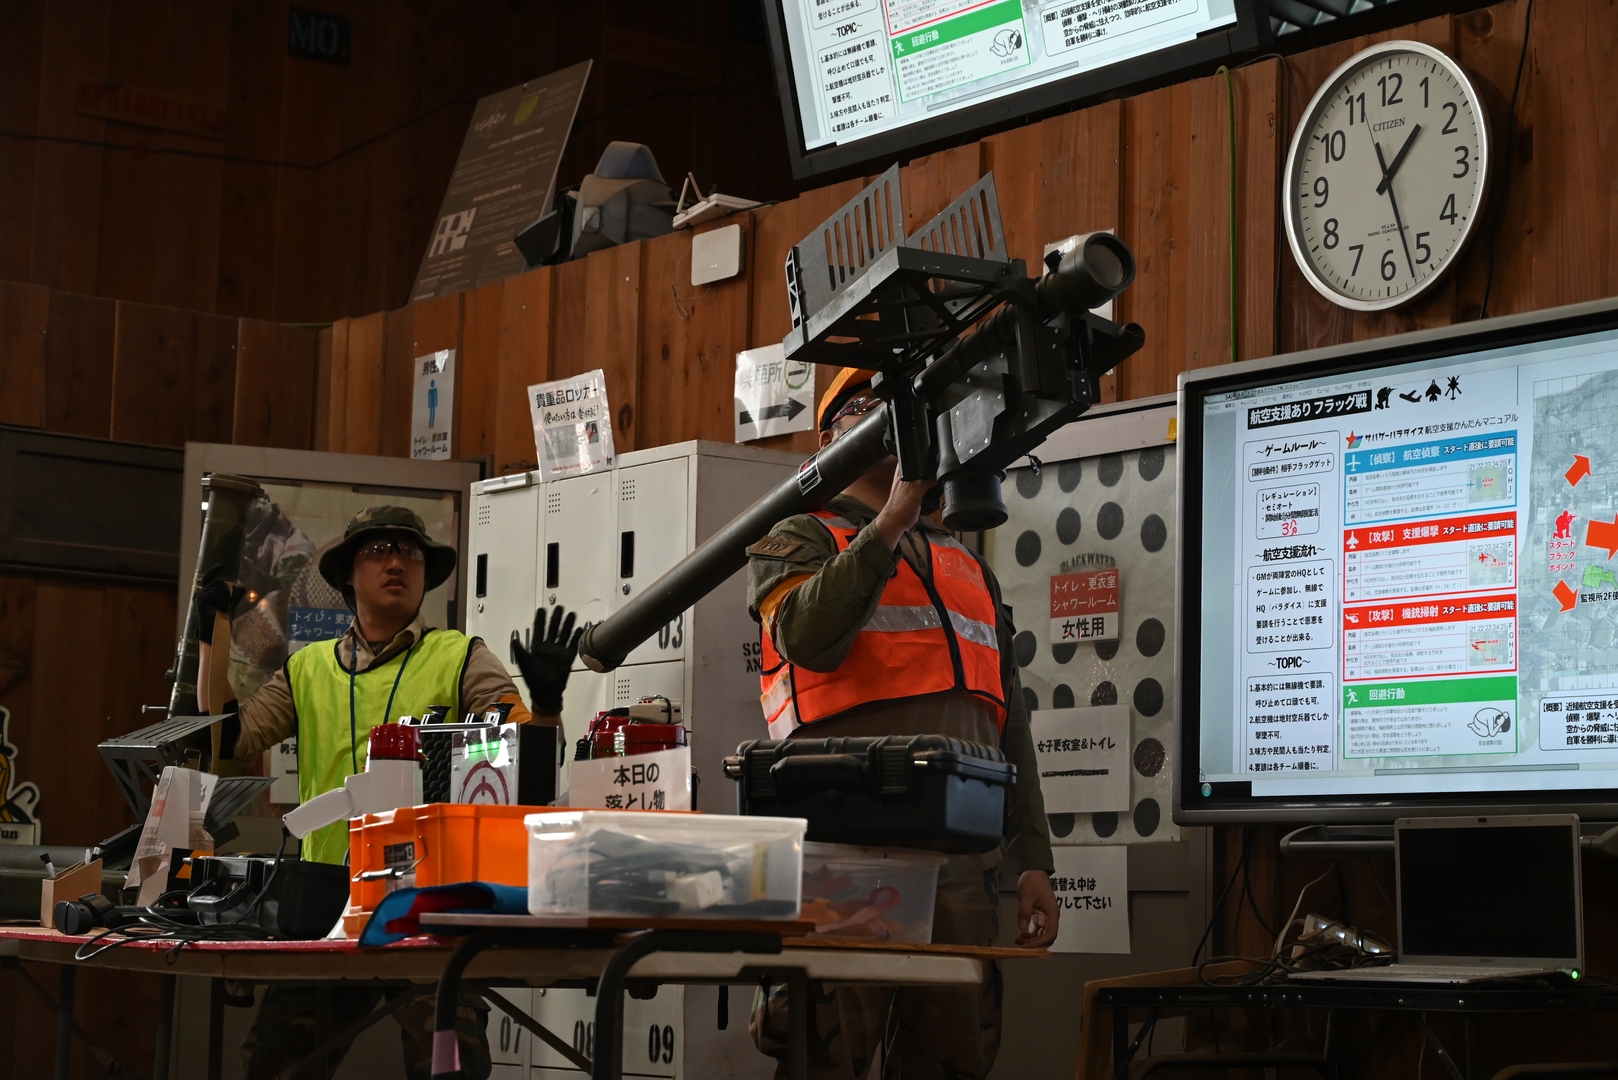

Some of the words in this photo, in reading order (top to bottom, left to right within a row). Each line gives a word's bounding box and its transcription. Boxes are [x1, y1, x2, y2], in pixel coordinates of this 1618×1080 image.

[911, 29, 939, 47] 回避行動
[1376, 72, 1403, 107] 12
[1419, 76, 1430, 108] 1
[1344, 92, 1366, 126] 11
[1441, 102, 1459, 135] 2
[1372, 117, 1406, 133] CITIZEN
[1320, 129, 1347, 164] 10
[1452, 145, 1471, 179] 3
[1313, 176, 1330, 208] 9
[1439, 193, 1459, 225] 4
[1323, 217, 1340, 250] 8
[1348, 243, 1365, 277] 7
[1415, 231, 1431, 265] 5
[1380, 249, 1397, 281] 6
[422, 359, 447, 376] 男性
[1250, 403, 1312, 425] 航空支援あり
[1314, 391, 1368, 414] フラッグ戦
[1369, 452, 1396, 467] 【偵察】
[1403, 447, 1441, 461] 航空偵察
[1443, 436, 1516, 455] スタート直後に要請可能
[1281, 459, 1331, 473] 相手フラッグゲット
[1368, 530, 1395, 543] 【攻撃】
[1403, 525, 1440, 540] 支援爆撃
[1443, 519, 1515, 535] スタート直後に要請可能
[1549, 541, 1575, 550] スタート
[1549, 552, 1575, 561] フラッグ
[1549, 563, 1575, 572] ポイント
[1053, 576, 1117, 594] トイレ・更衣室
[1053, 595, 1116, 612] シャワールーム
[1367, 610, 1394, 622] 【攻撃】
[1402, 606, 1439, 618] 機銃掃射
[1442, 600, 1515, 615] スタート直後に要請可能
[1062, 617, 1105, 640] 女性用
[1369, 688, 1405, 701] 回避行動
[613, 763, 660, 786] 本日の
[605, 790, 665, 810] 落とし物
[648, 1024, 674, 1064] 09
